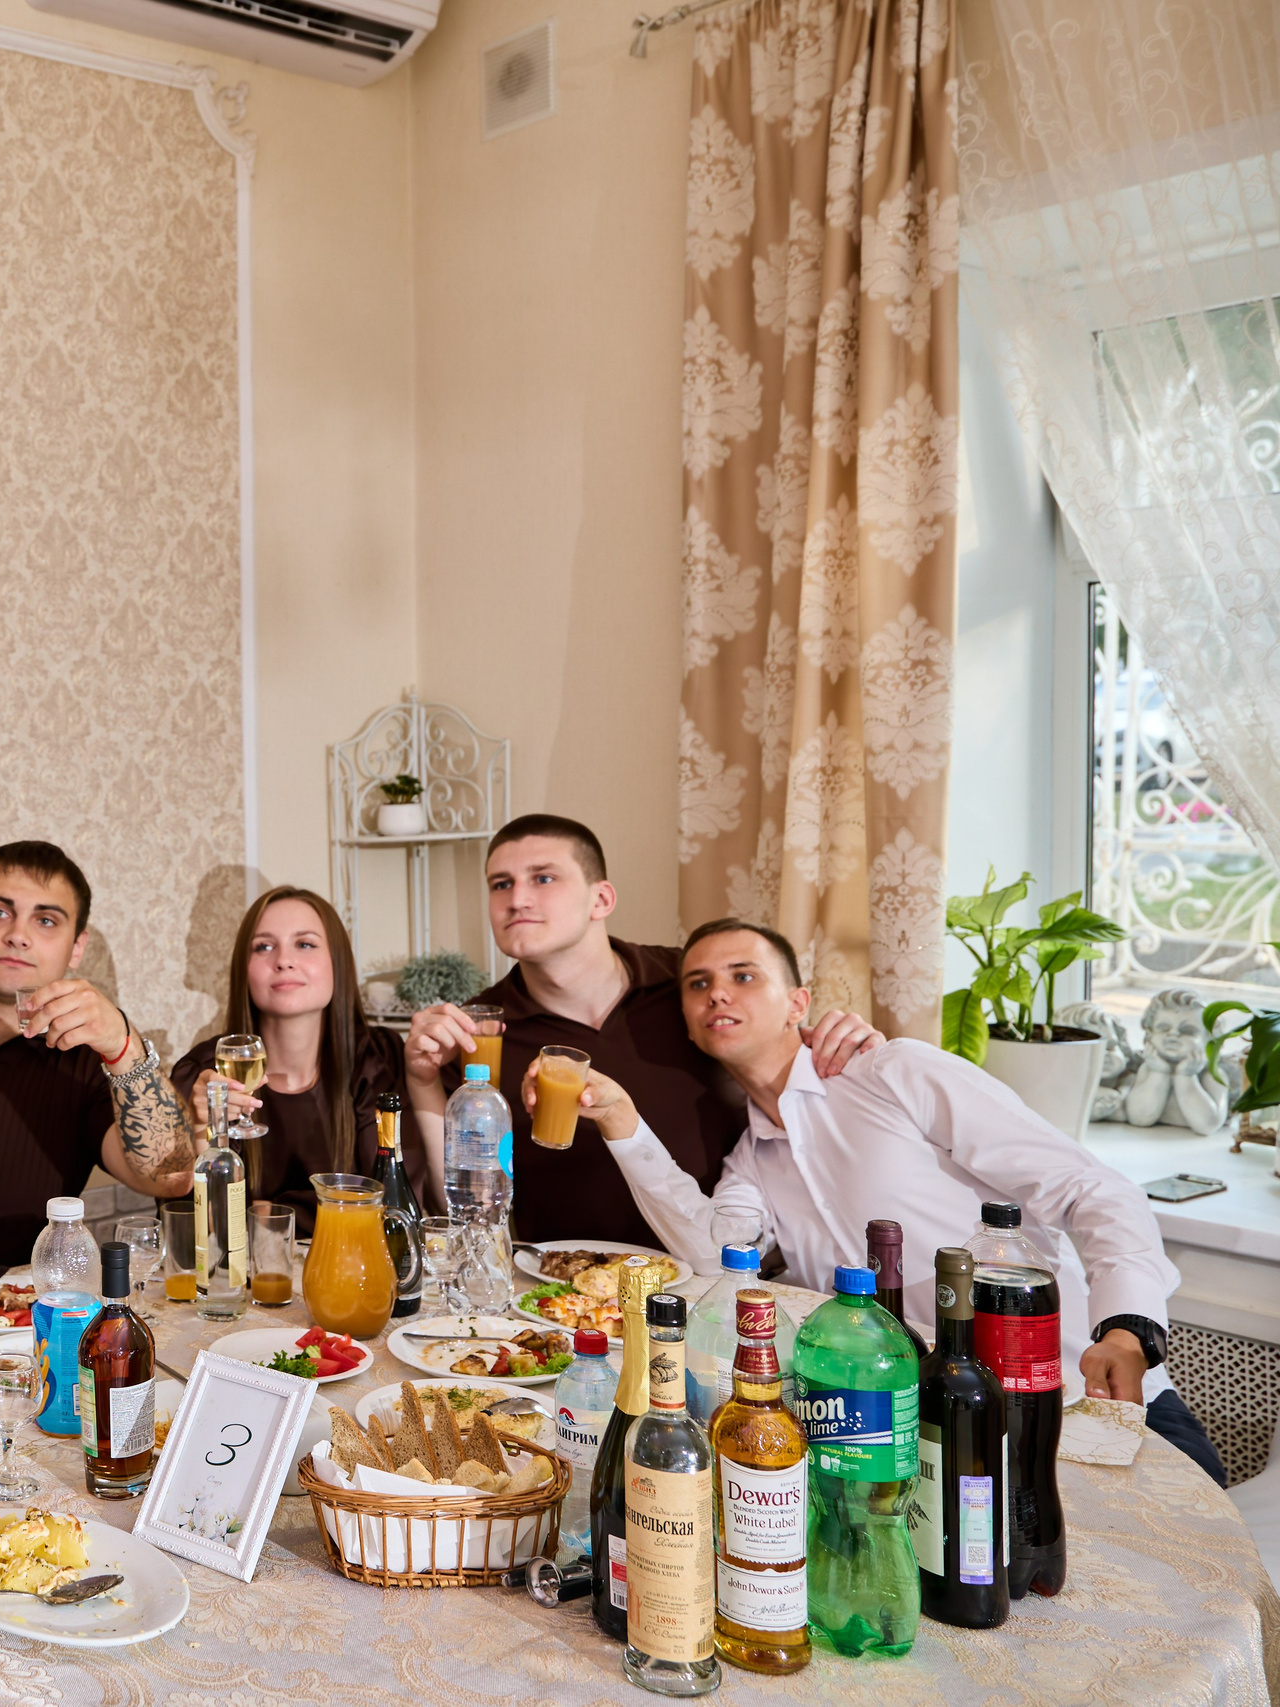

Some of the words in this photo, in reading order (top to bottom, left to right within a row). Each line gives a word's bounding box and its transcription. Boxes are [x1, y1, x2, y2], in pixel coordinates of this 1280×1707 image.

[810, 1421, 839, 1436] lime
[205, 1423, 252, 1466] 3
[844, 1445, 863, 1454] 100%
[820, 1446, 843, 1456] NATURAL
[844, 1451, 873, 1460] FLAVOURS
[727, 1480, 800, 1506] Dewar's
[728, 1577, 748, 1592] John
[748, 1582, 776, 1595] Dewar
[783, 1585, 800, 1595] Sons
[656, 1614, 677, 1627] 1898
